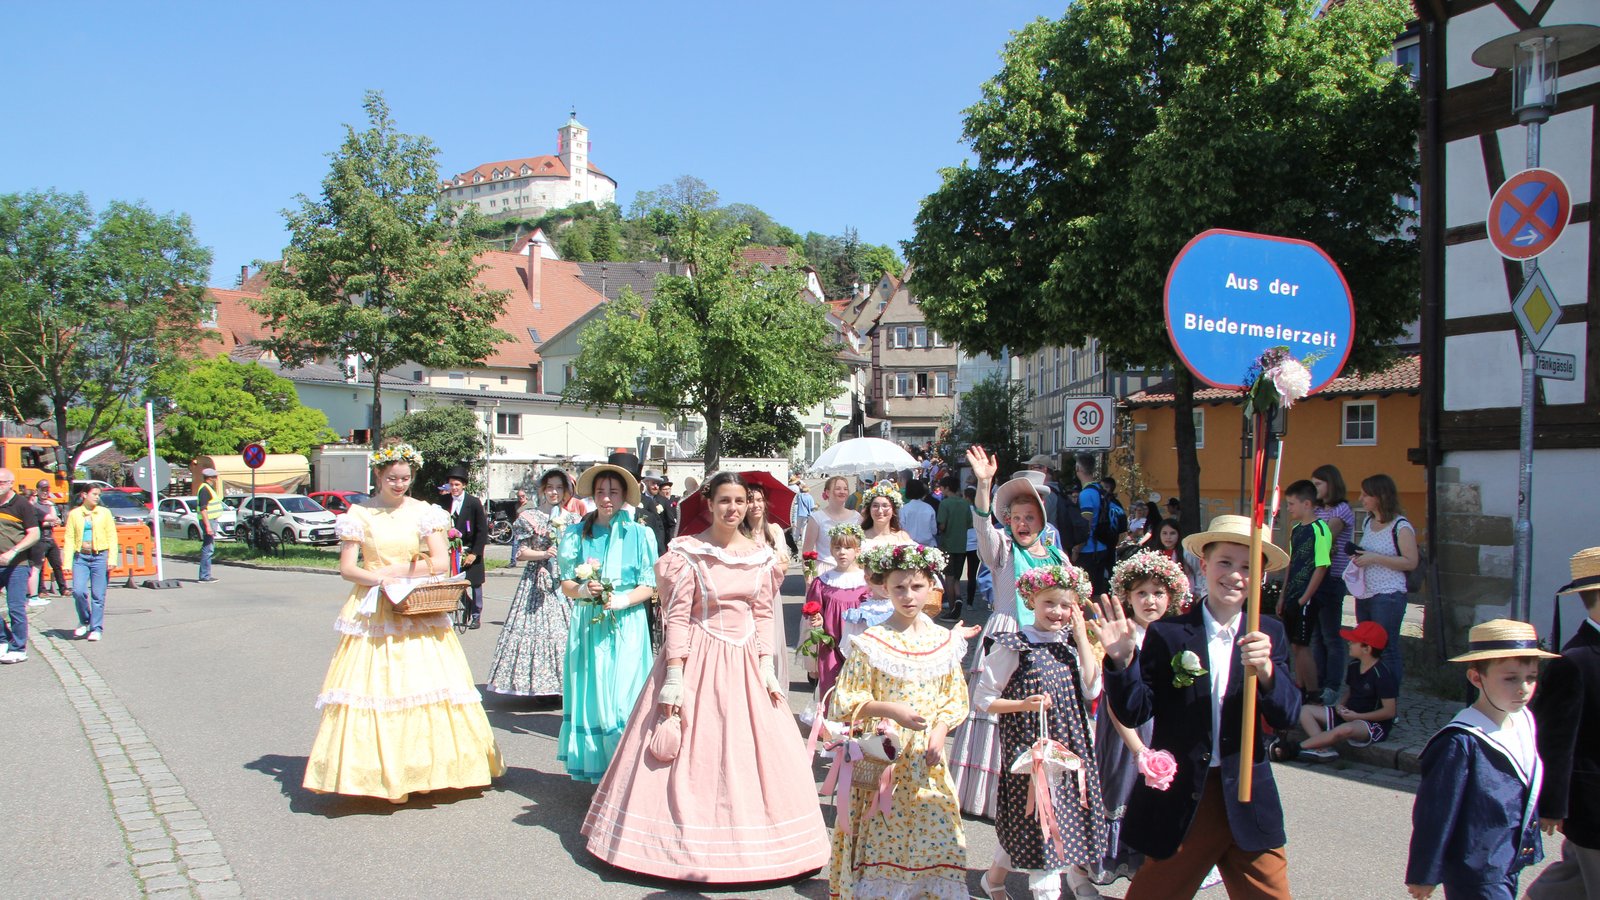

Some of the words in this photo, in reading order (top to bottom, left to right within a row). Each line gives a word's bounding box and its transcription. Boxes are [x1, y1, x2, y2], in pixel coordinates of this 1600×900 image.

[1225, 272, 1259, 291] Aus
[1269, 278, 1300, 297] der
[1184, 313, 1336, 347] Biedermeierzeit
[1535, 355, 1573, 374] Tränkgässle
[1079, 410, 1098, 425] 30
[1076, 436, 1100, 445] ZONE
